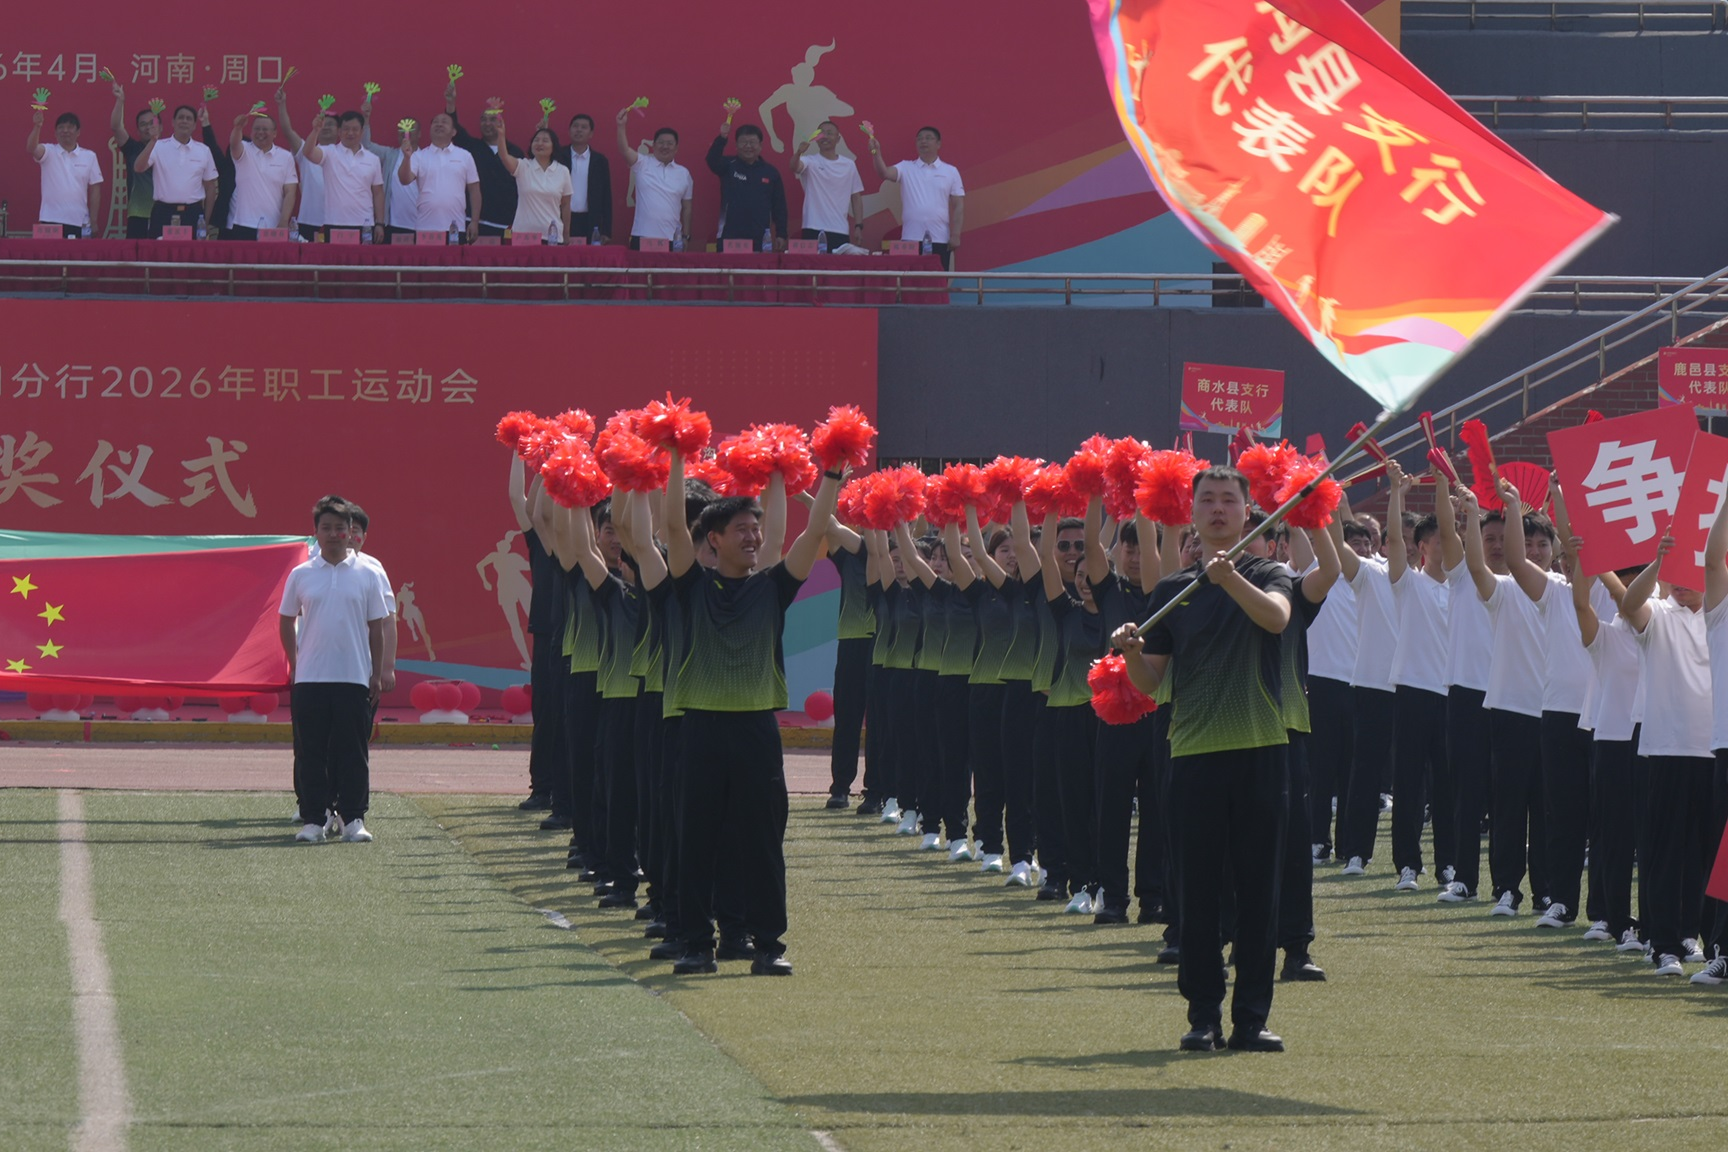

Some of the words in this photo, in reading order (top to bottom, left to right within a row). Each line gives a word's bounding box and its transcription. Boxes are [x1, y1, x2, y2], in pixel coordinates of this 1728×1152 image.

[130, 53, 284, 85] 河南·周口
[1187, 36, 1363, 237] 代表队
[1197, 379, 1269, 397] 商水县支行
[1211, 397, 1252, 414] 代表队
[1581, 439, 1686, 545] 争
